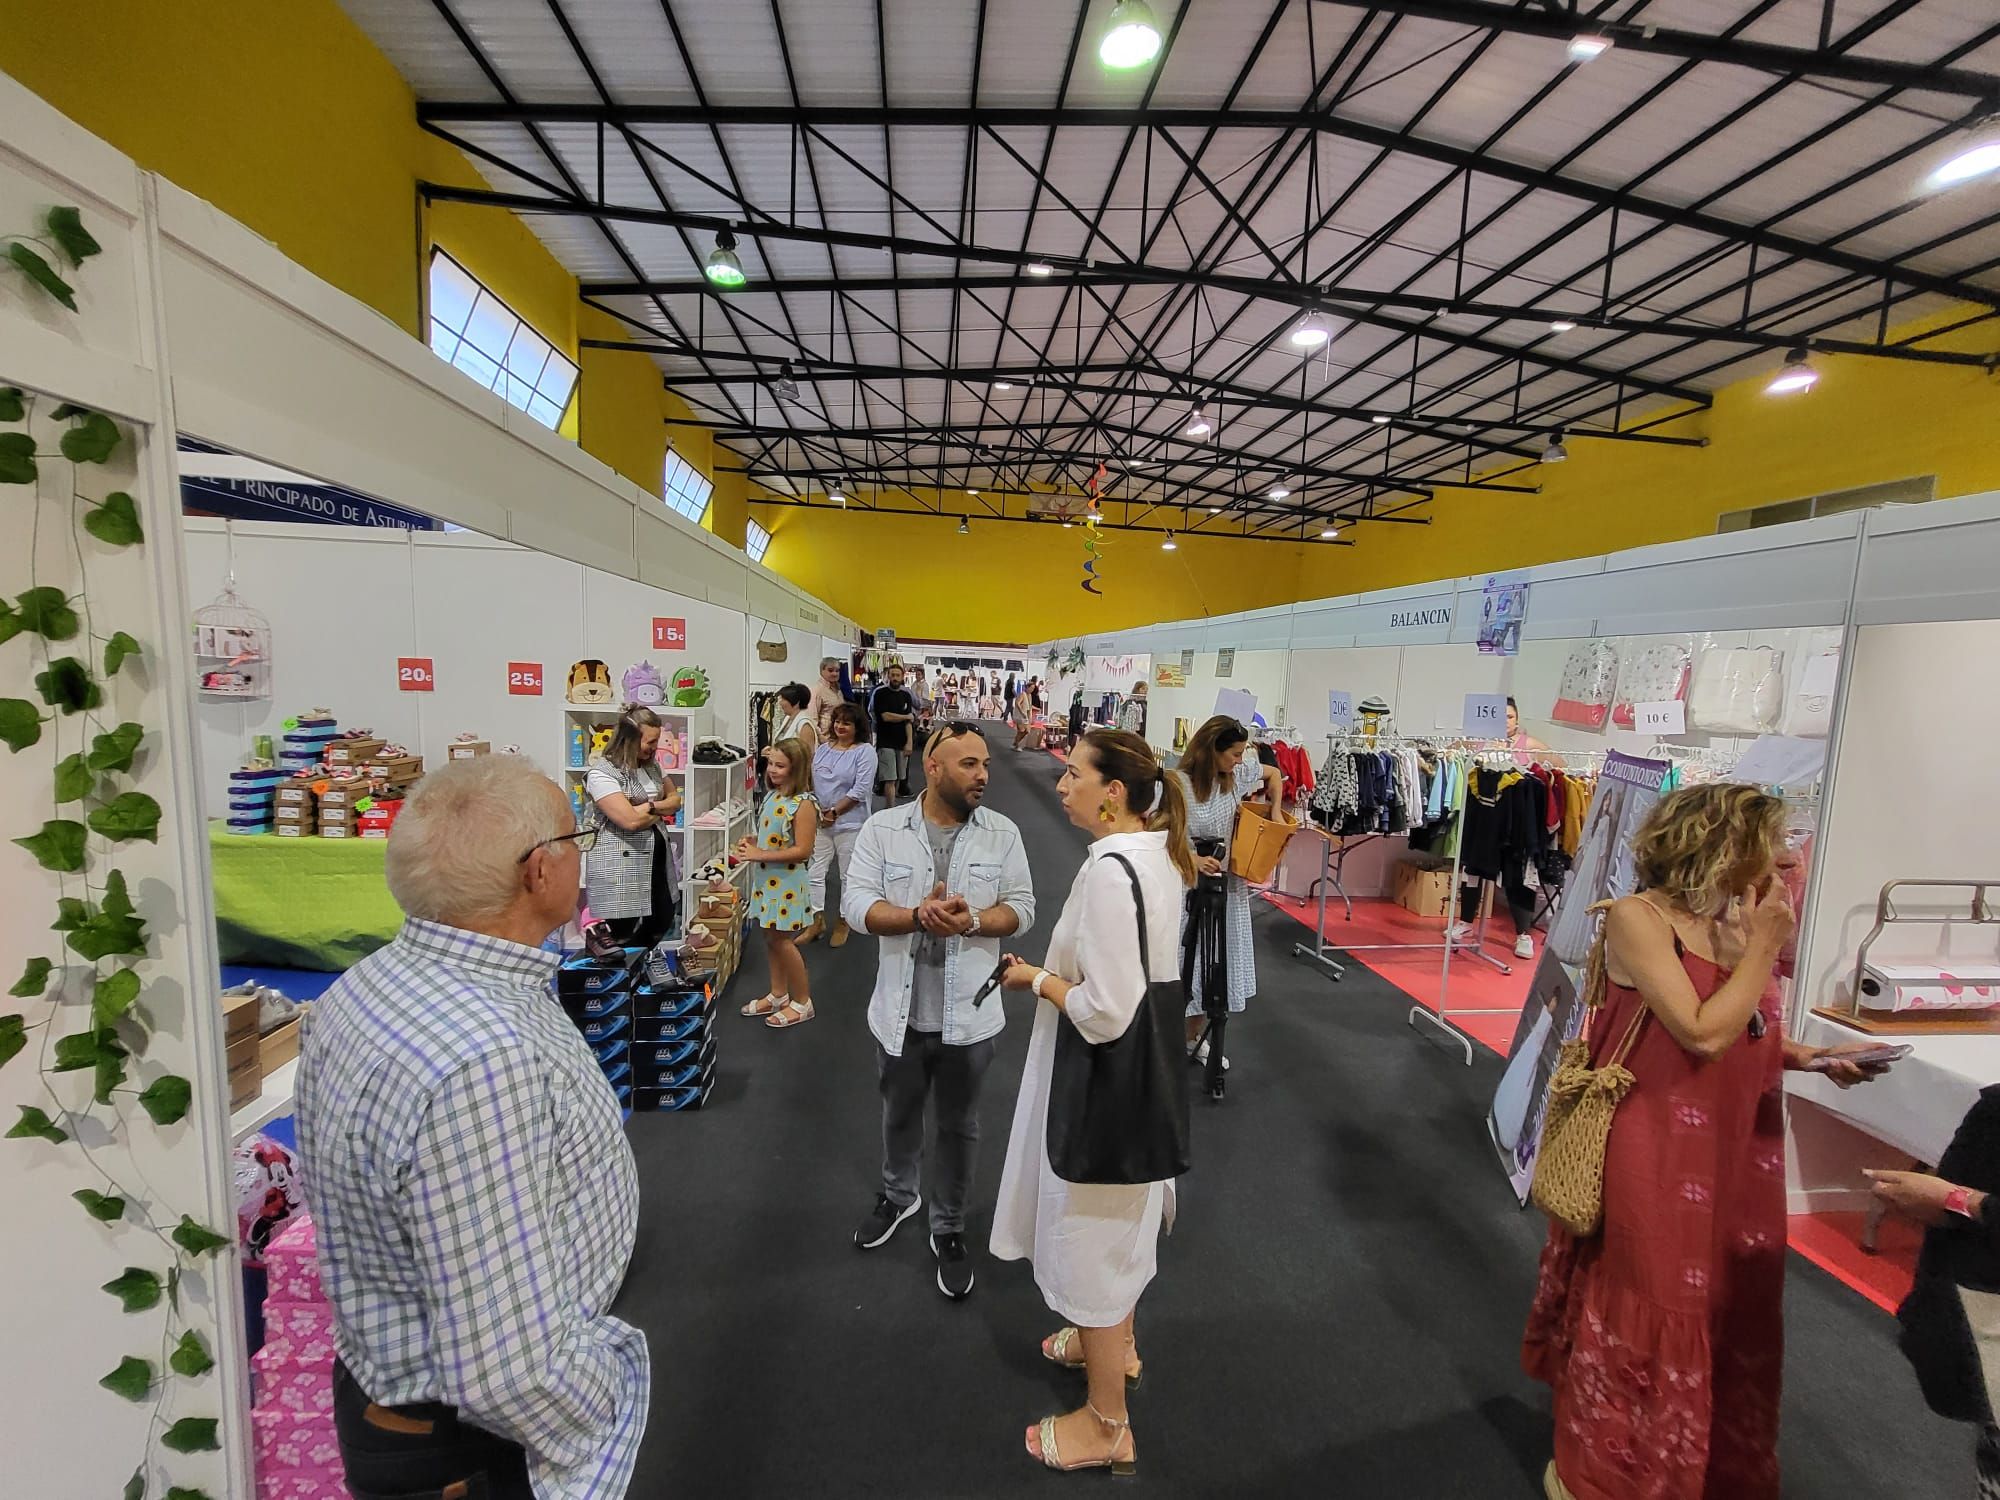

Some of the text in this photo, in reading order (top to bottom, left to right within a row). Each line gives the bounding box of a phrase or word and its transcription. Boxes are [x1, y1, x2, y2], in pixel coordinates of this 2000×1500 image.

[341, 504, 361, 521] DE
[1390, 608, 1452, 628] BALANCIN
[1604, 759, 1664, 789] COMUNIONES
